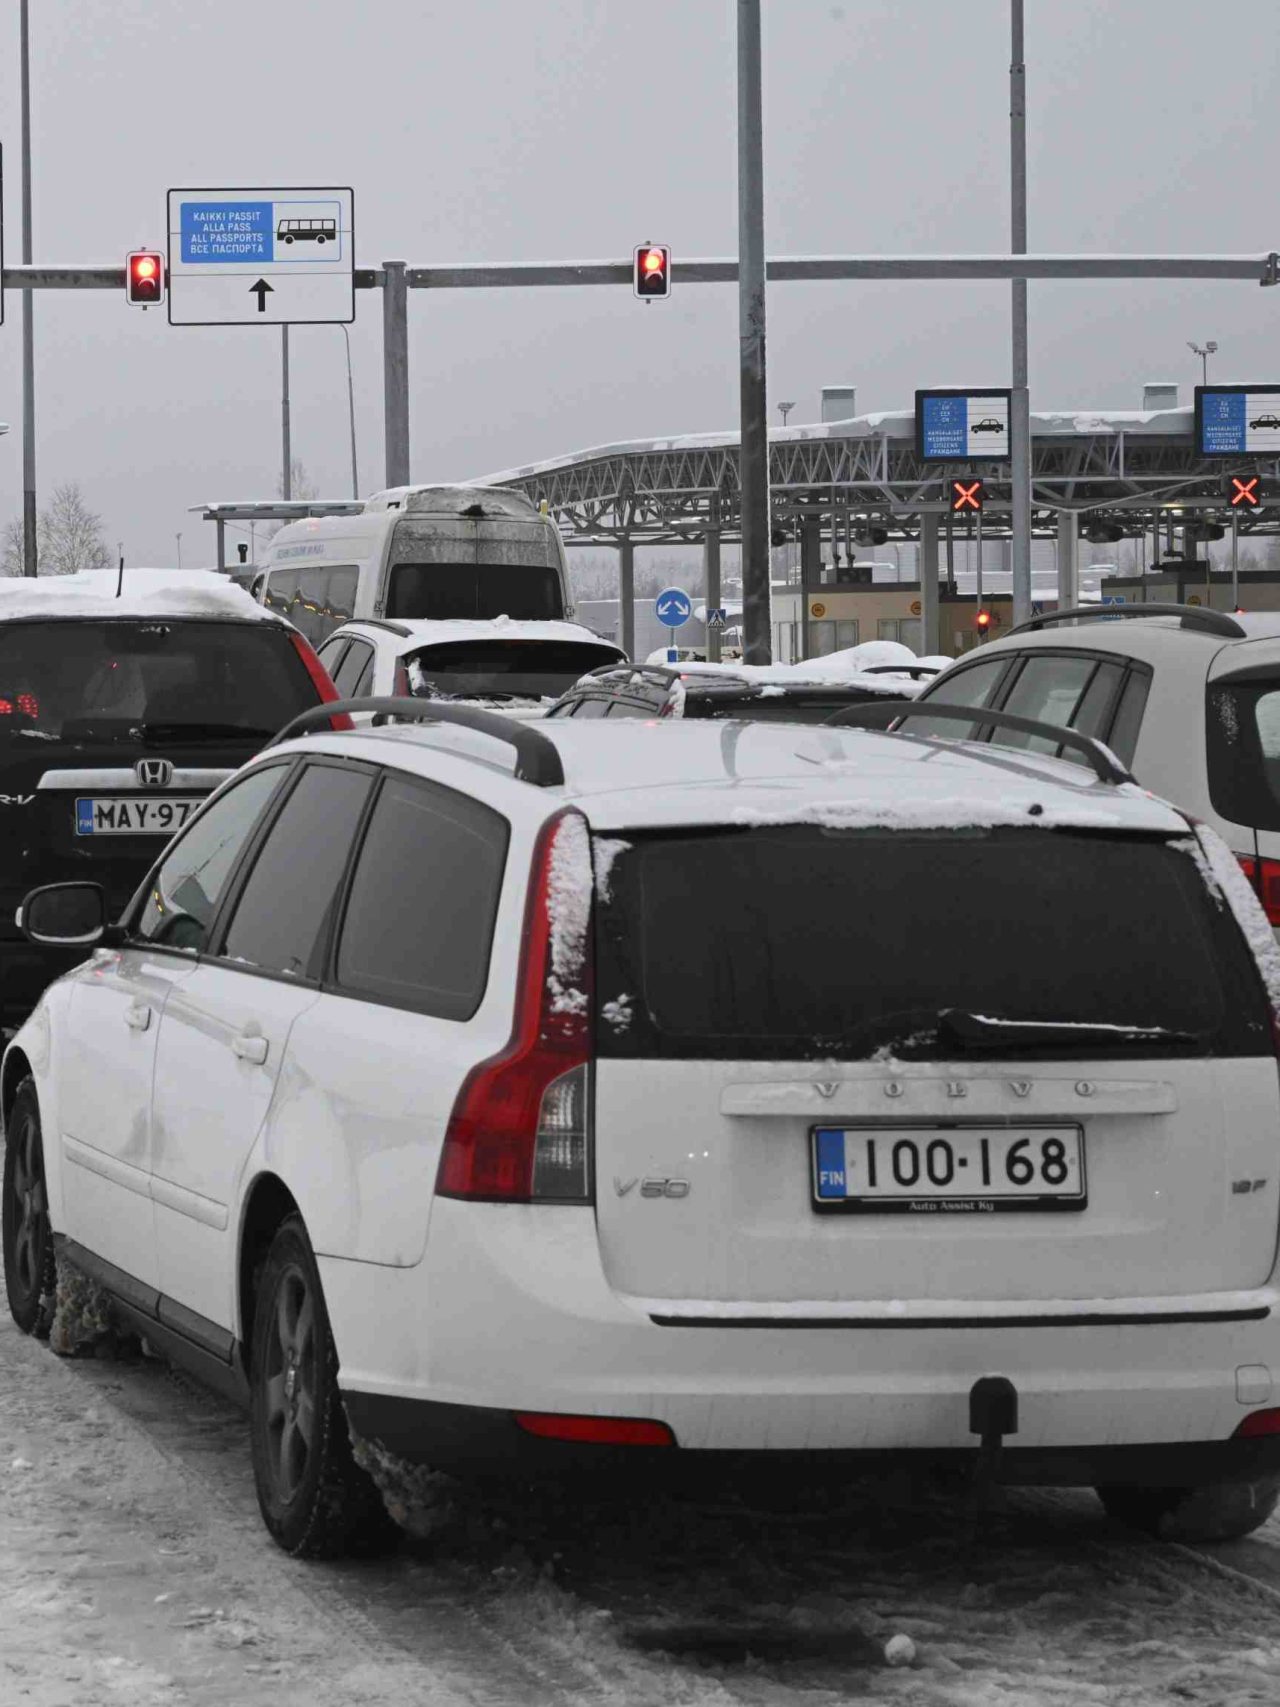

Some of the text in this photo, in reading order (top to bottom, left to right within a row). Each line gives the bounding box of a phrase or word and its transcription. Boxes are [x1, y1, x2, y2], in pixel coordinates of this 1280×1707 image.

[193, 212, 261, 222] KAIKKI PASSIT
[203, 223, 251, 232] ALLA PASS
[191, 233, 263, 243] ALL PASSPORTS
[191, 244, 264, 254] ВСЕ ПАСПОРТА
[97, 803, 203, 828] MAY-97
[815, 1081, 1096, 1098] VOLVO
[866, 1138, 1068, 1188] 100-168
[820, 1171, 844, 1185] FIN
[909, 1201, 994, 1212] Auto Assist Ky
